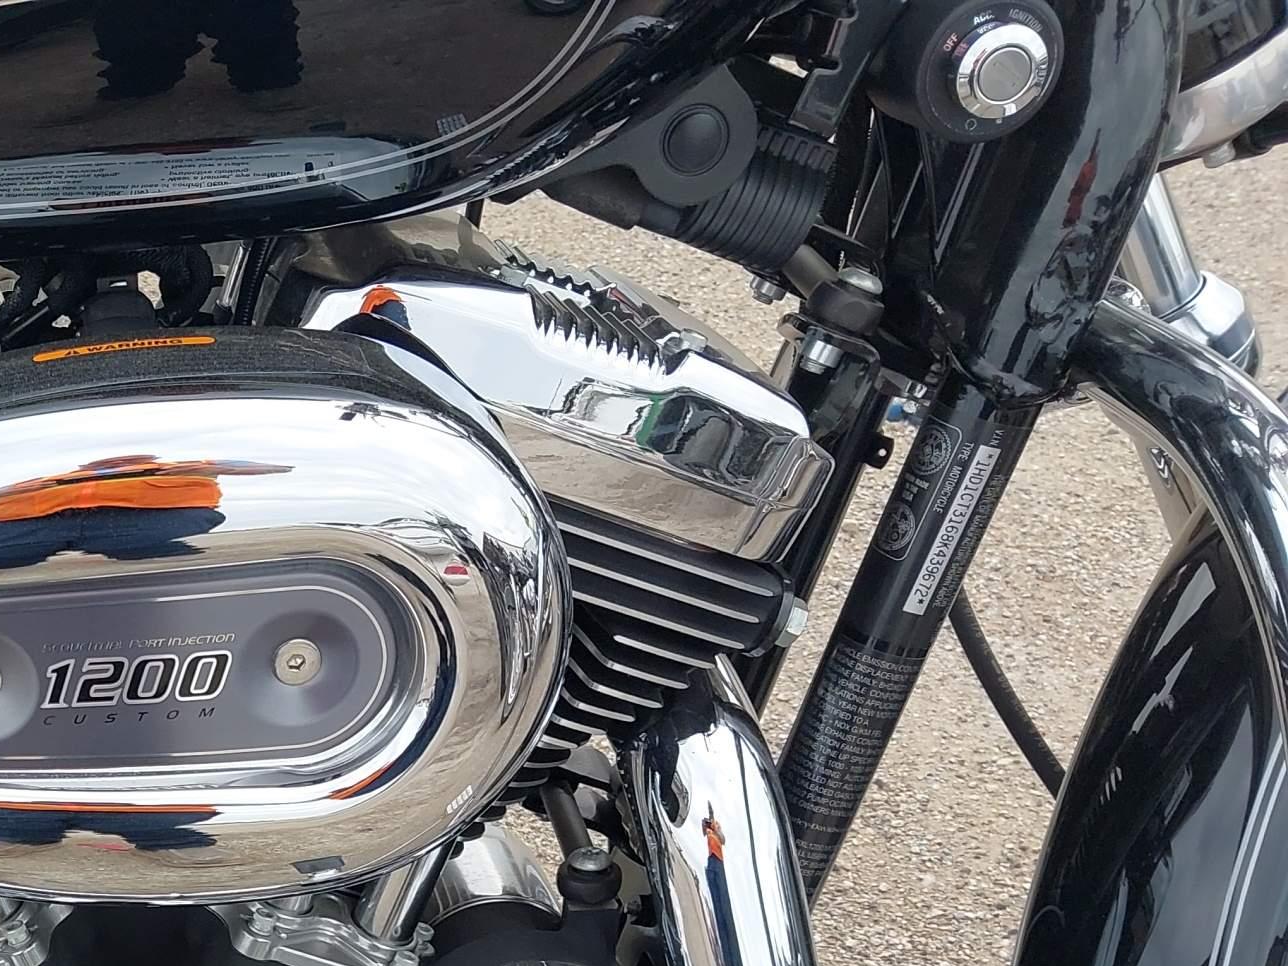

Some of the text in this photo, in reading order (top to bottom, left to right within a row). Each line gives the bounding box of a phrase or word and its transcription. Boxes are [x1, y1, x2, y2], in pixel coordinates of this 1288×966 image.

[1008, 8, 1043, 33] IGNITION
[943, 32, 960, 52] OFF
[88, 340, 183, 352] WARNING
[933, 463, 961, 513] MOTORCYCLE
[128, 638, 166, 649] PORT
[167, 632, 235, 648] INJECTION
[861, 654, 898, 670] EMISSION
[40, 650, 232, 709] 1200
[836, 677, 866, 694] VEHICLE
[837, 699, 858, 712] YEAR
[857, 705, 875, 716] NEW
[43, 707, 215, 726] CUSTOM
[823, 726, 856, 742] EXHAUST
